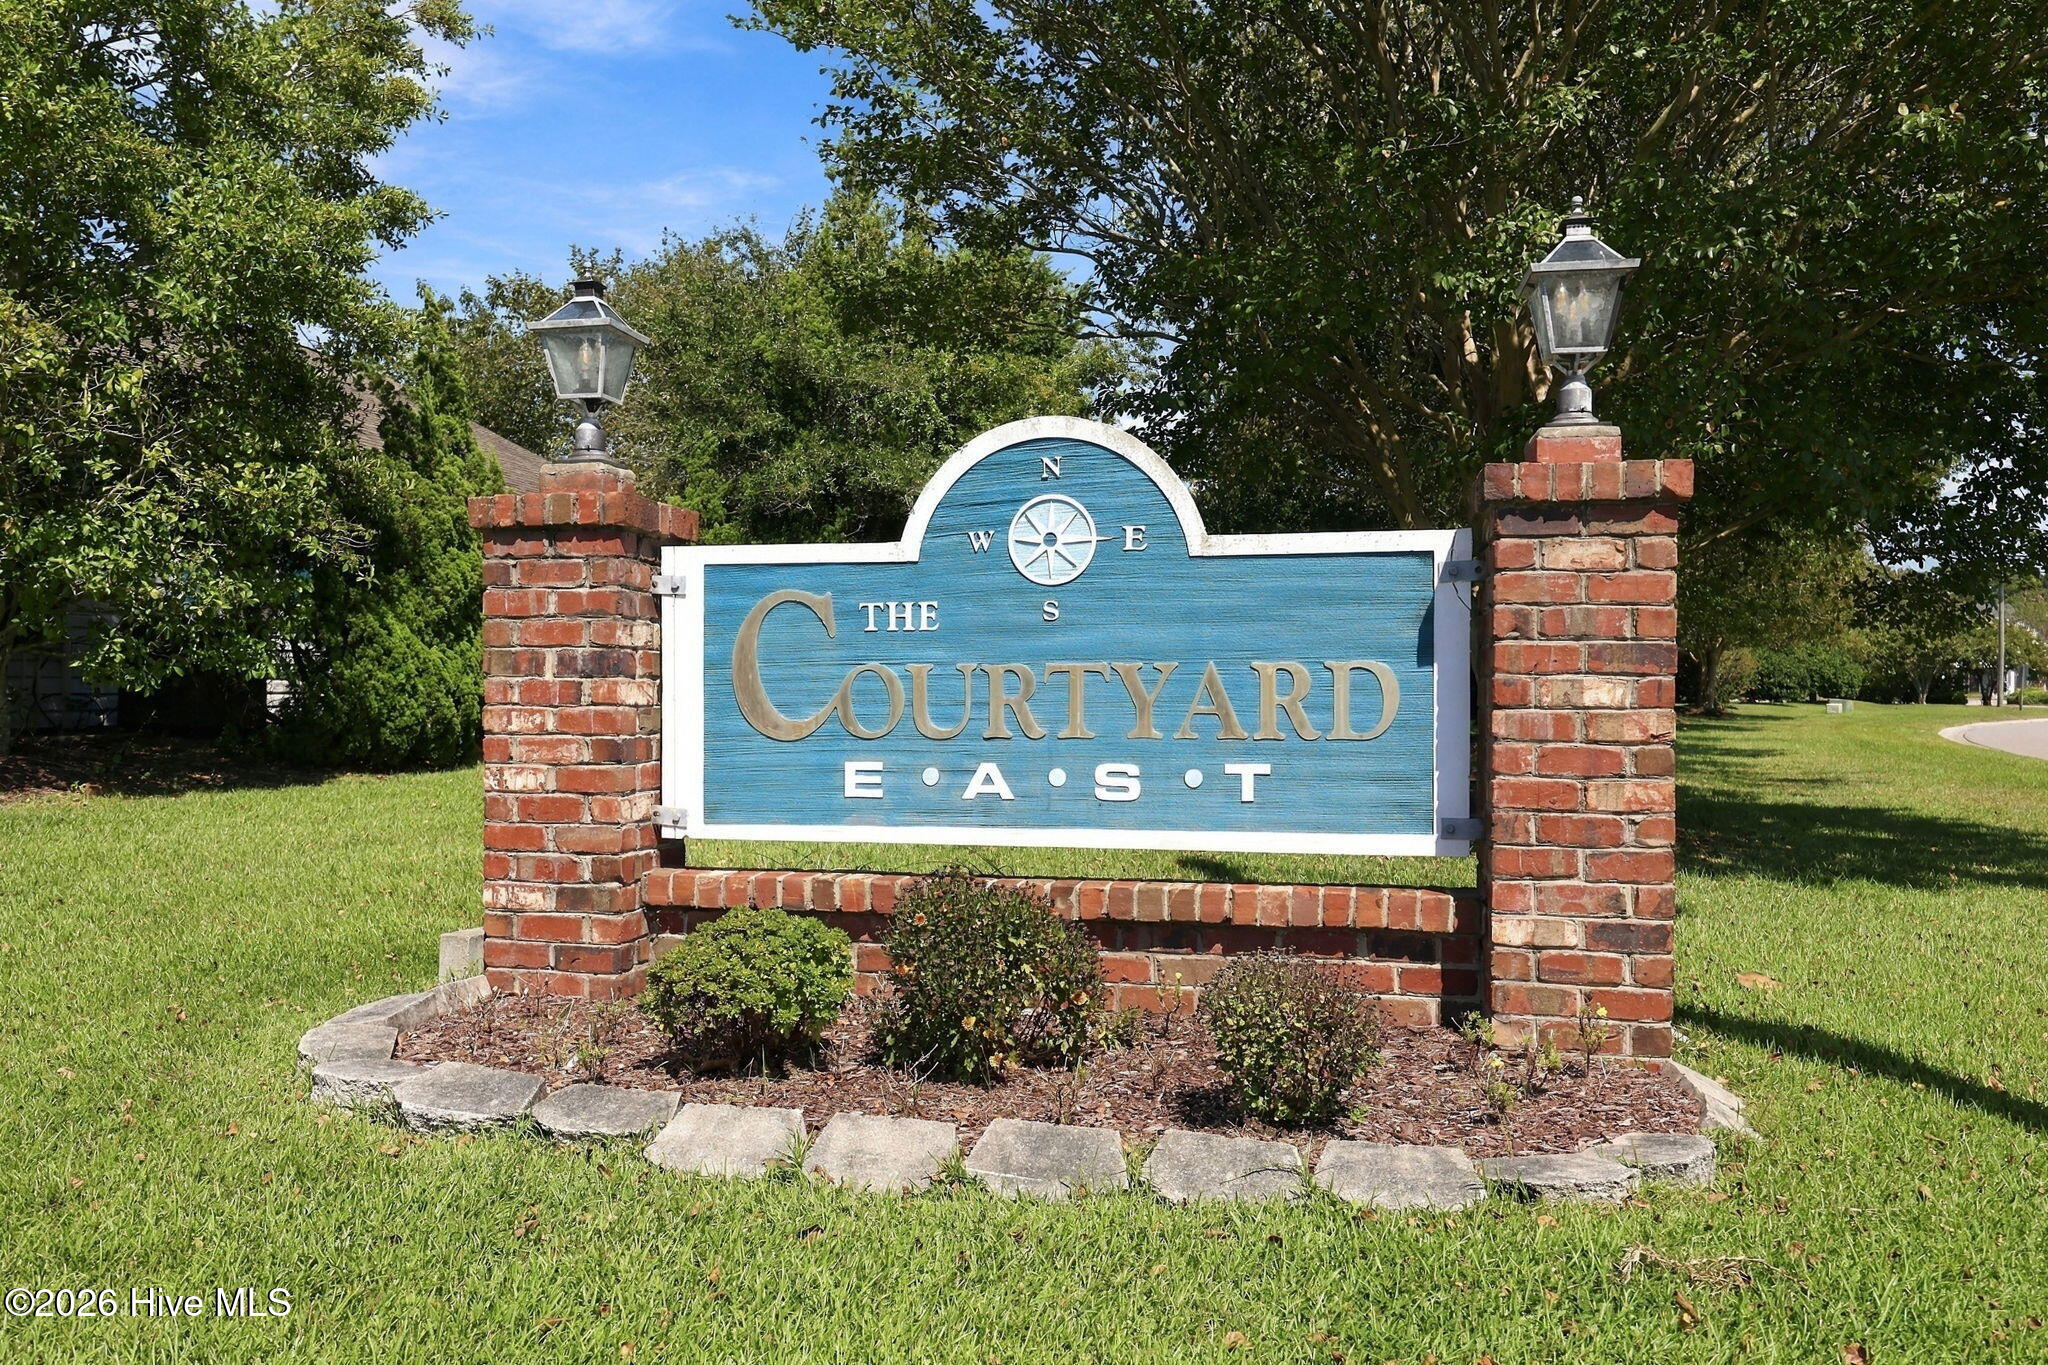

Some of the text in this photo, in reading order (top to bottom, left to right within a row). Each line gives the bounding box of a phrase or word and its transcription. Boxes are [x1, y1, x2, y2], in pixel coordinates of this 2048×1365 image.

[1041, 456, 1062, 479] N
[968, 530, 996, 554] W
[1122, 525, 1149, 551] E
[858, 601, 940, 632] THE
[1042, 600, 1061, 622] S
[732, 590, 1401, 742] COURTYARD
